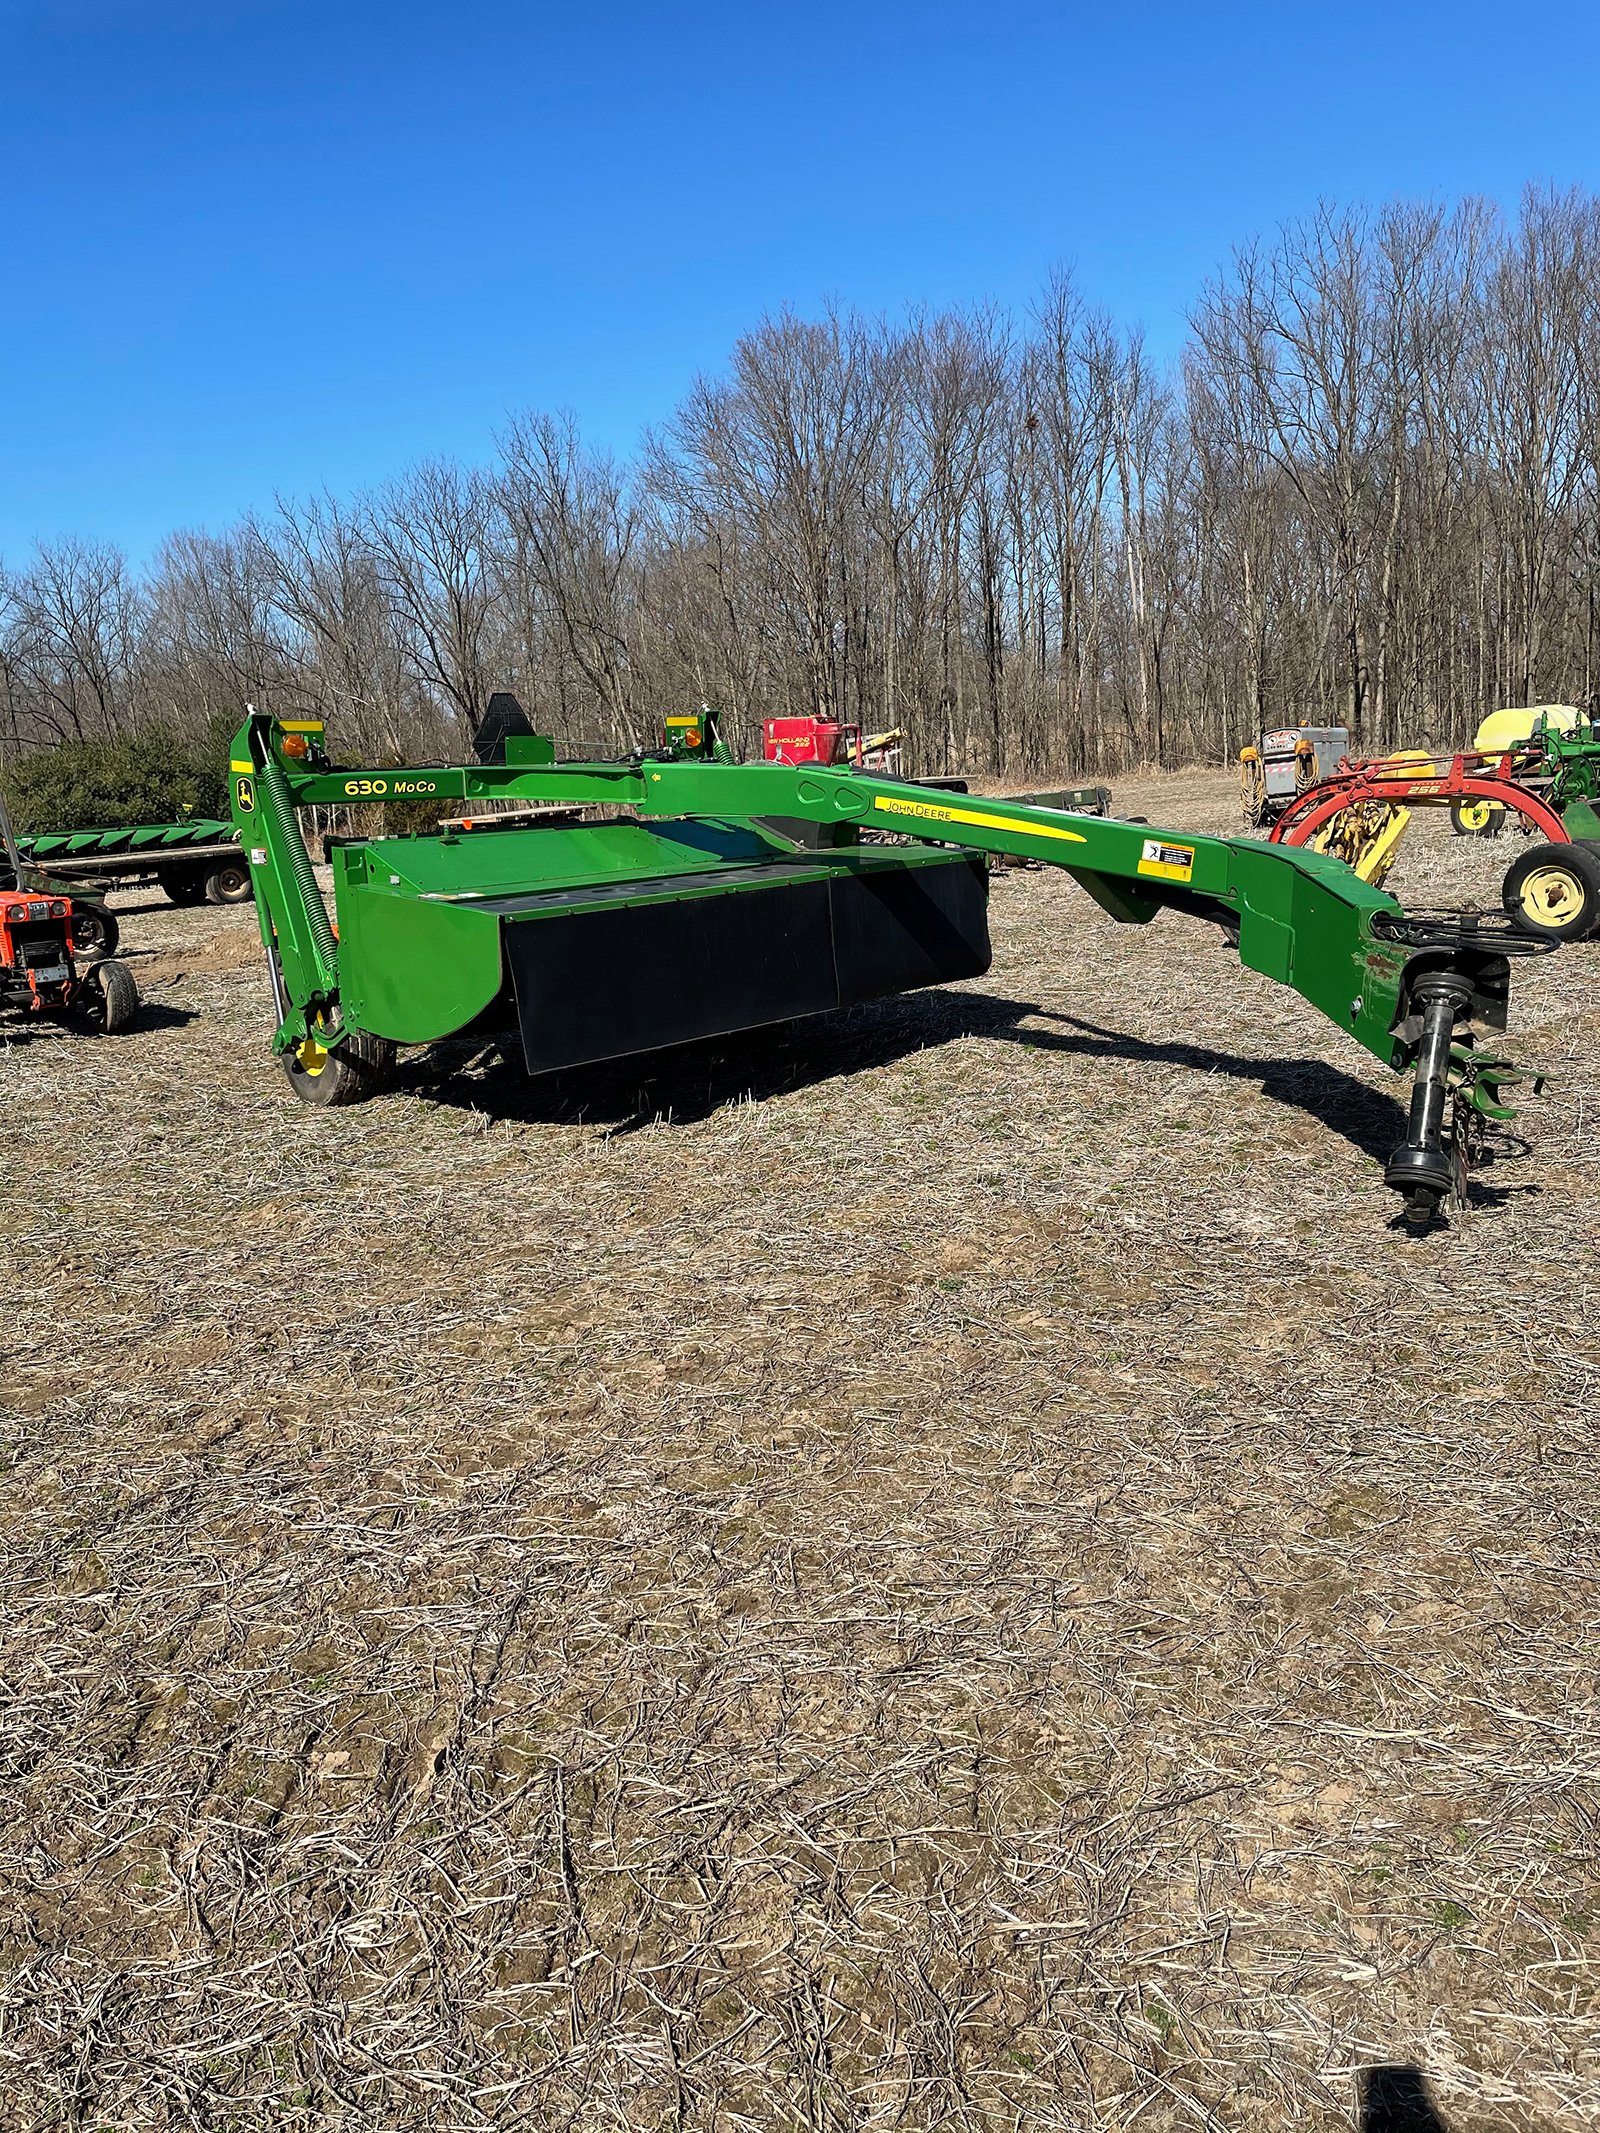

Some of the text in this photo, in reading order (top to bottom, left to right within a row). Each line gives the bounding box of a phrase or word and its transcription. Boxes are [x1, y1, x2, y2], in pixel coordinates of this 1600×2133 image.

[344, 780, 436, 795] 630 MoCo
[1407, 786, 1441, 794] 256
[886, 801, 952, 820] JOHN DEERE
